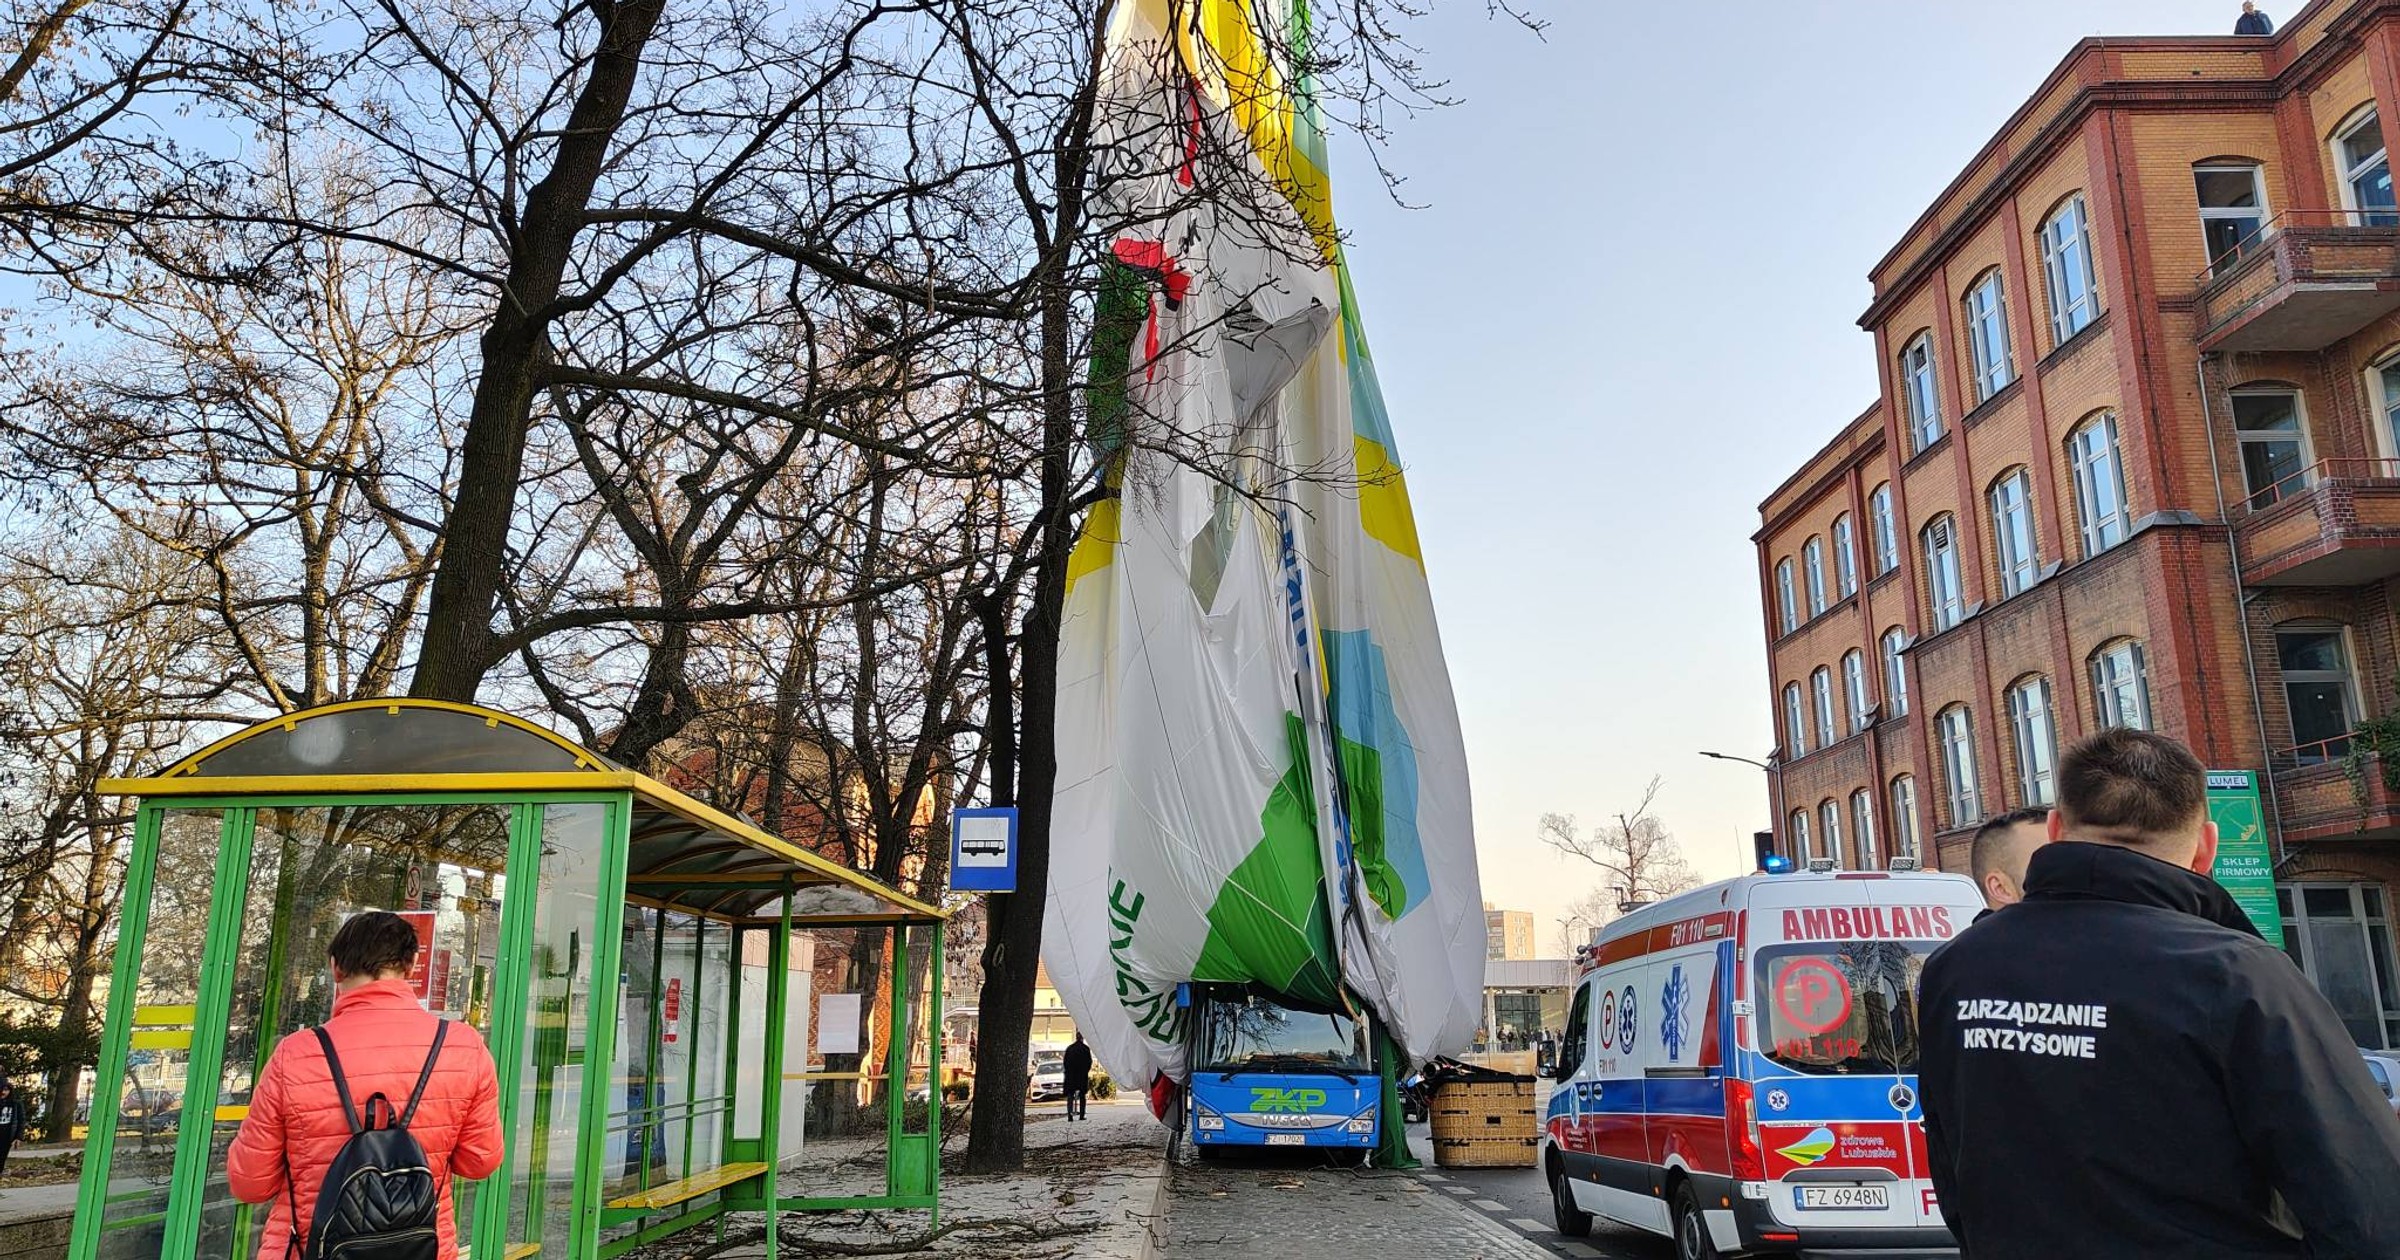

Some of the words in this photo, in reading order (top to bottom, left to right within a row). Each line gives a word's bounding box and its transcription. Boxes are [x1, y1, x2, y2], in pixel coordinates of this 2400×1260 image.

[2209, 775, 2248, 785] LUMEL
[2215, 867, 2271, 877] FIRMOWY
[2222, 857, 2260, 866] SKLEP
[1670, 923, 1687, 947] F01
[1688, 918, 1705, 945] 110
[1782, 906, 1954, 941] AMBULANS
[1801, 974, 1831, 1017] P
[1604, 1004, 1612, 1037] P
[1957, 999, 2108, 1028] ZARZĄDZANIE
[1822, 1037, 1861, 1059] 110
[1963, 1027, 2096, 1059] KRYZYSOWE
[1251, 1087, 1327, 1113] ZKP
[1262, 1115, 1312, 1126] IVECO
[1840, 1134, 1885, 1146] zdrowe
[1840, 1146, 1897, 1159] Lubuskie
[1806, 1189, 1828, 1205] FZ
[1833, 1189, 1883, 1205] 6948N
